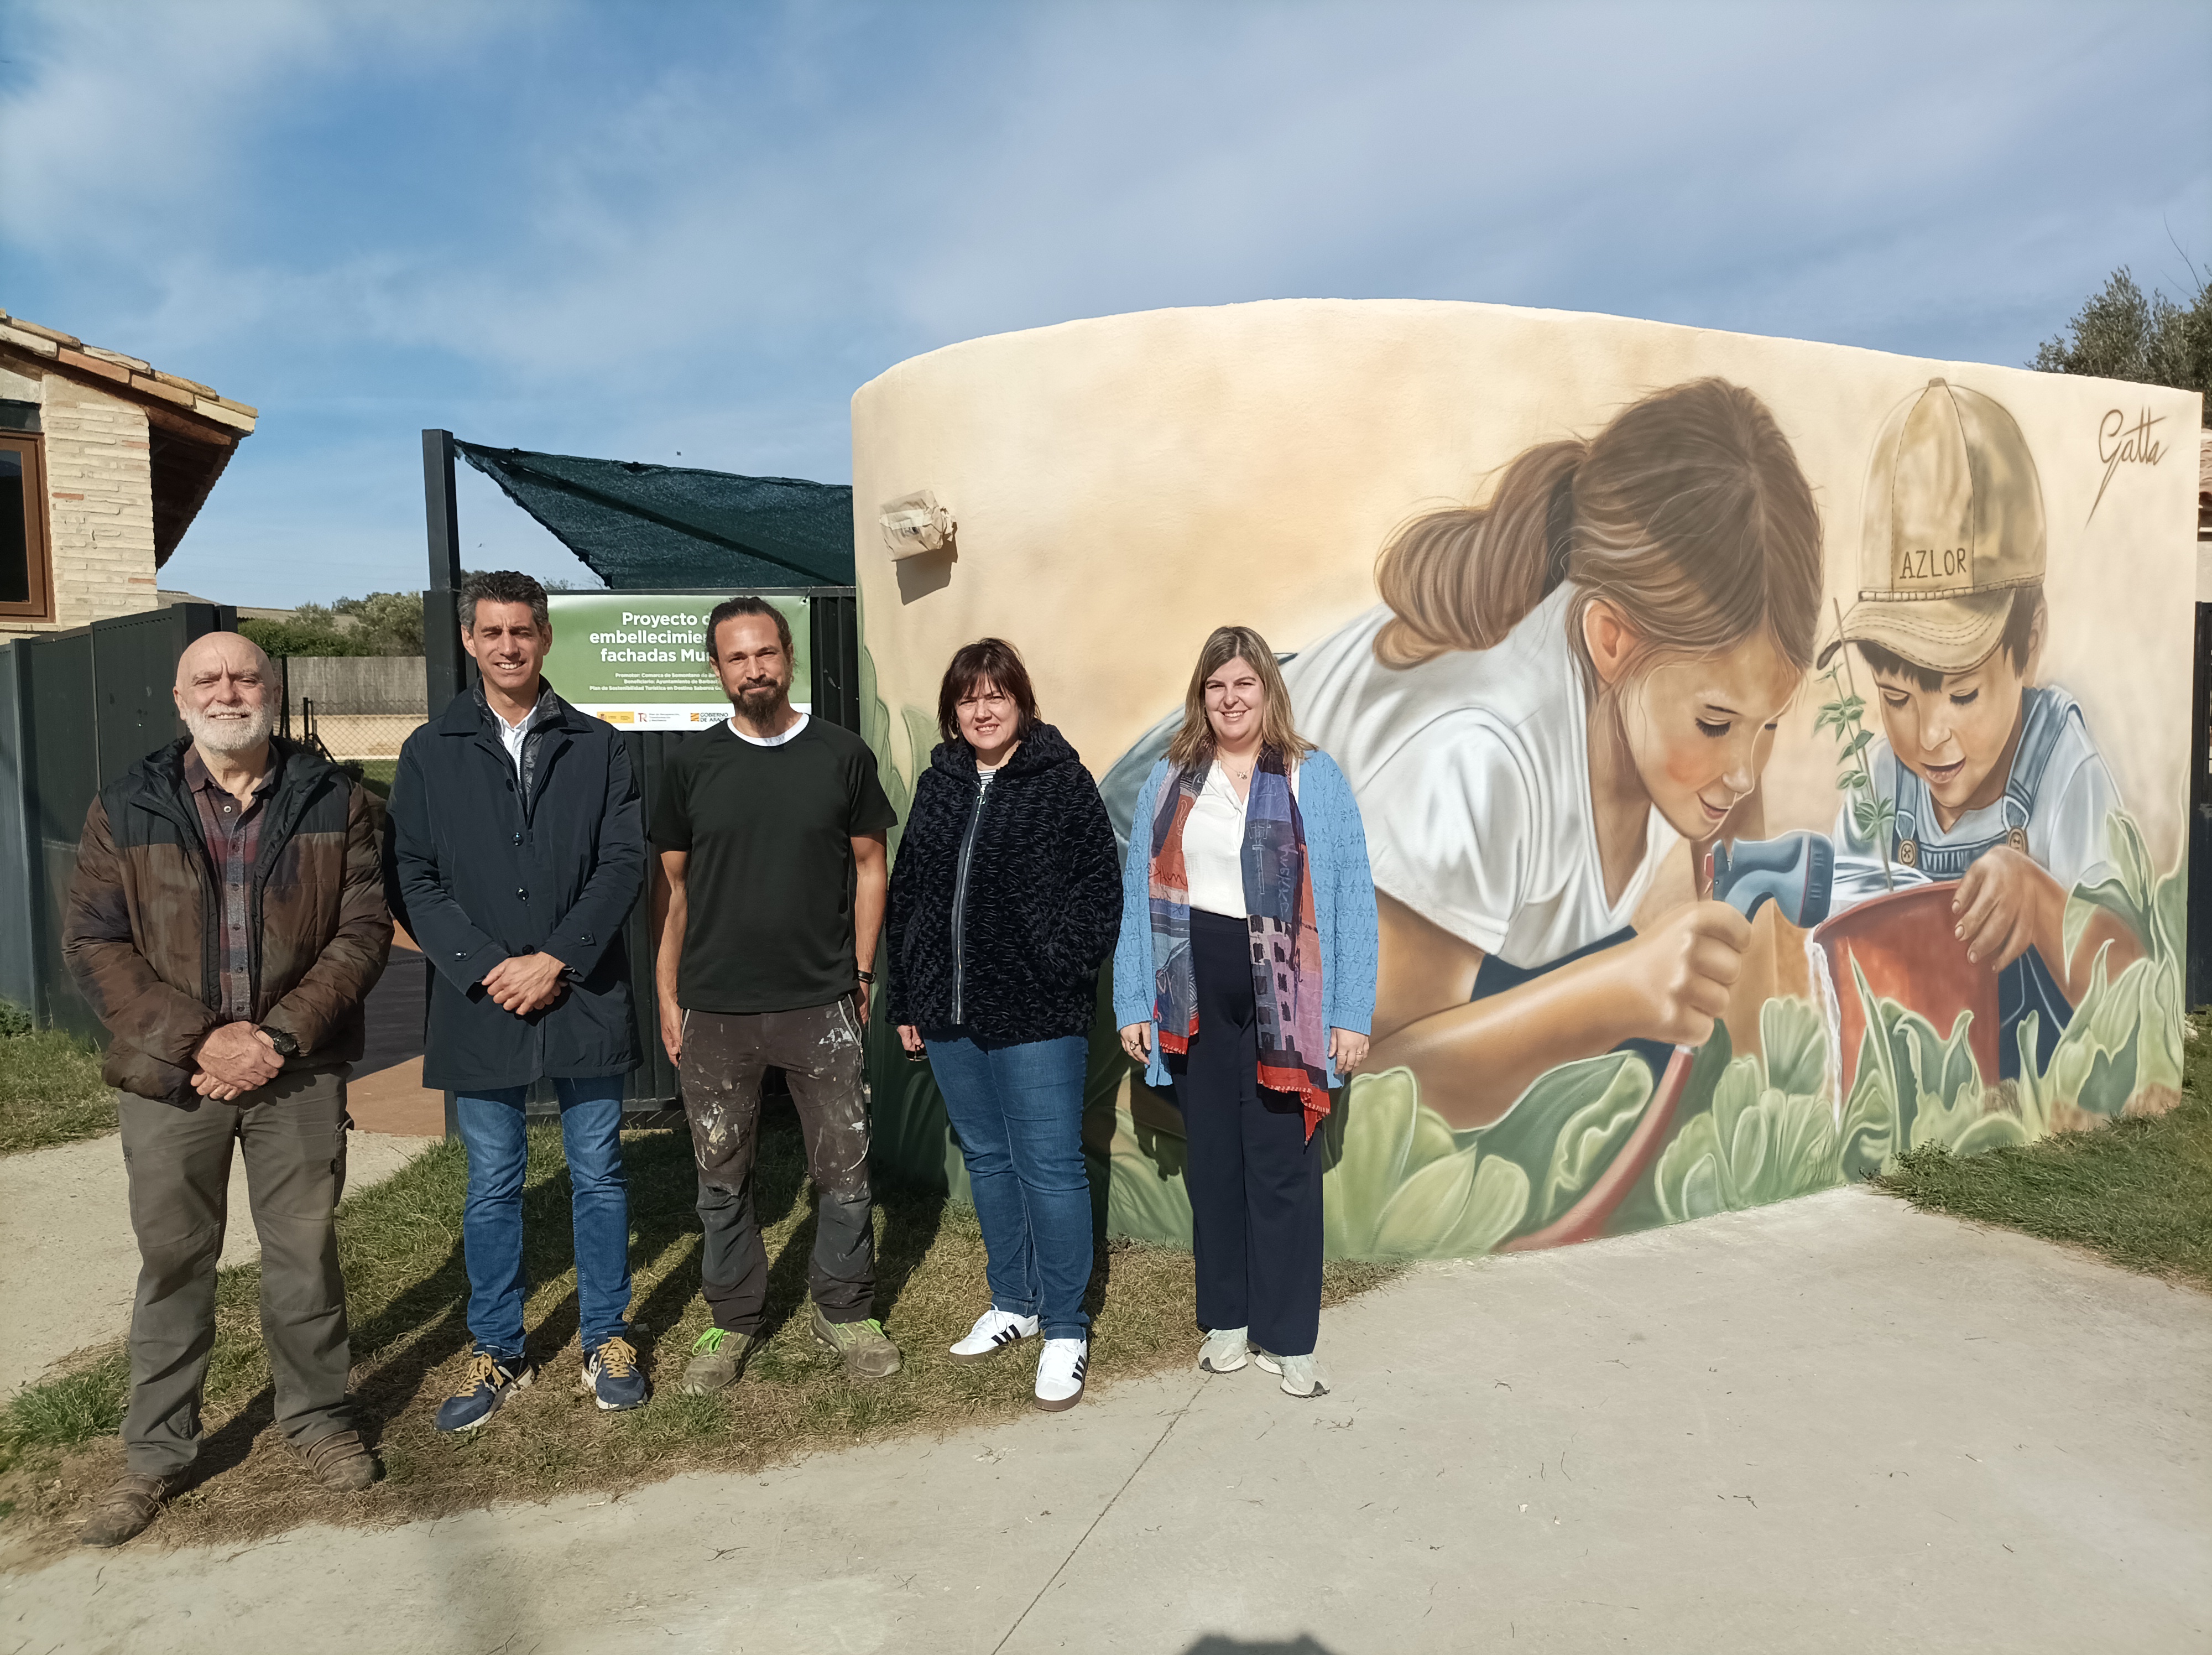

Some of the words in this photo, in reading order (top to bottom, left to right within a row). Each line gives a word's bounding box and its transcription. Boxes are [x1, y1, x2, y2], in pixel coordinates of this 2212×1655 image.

[1900, 548, 1966, 579] AZLOR
[622, 612, 698, 628] Proyecto
[601, 648, 676, 662] fachadas
